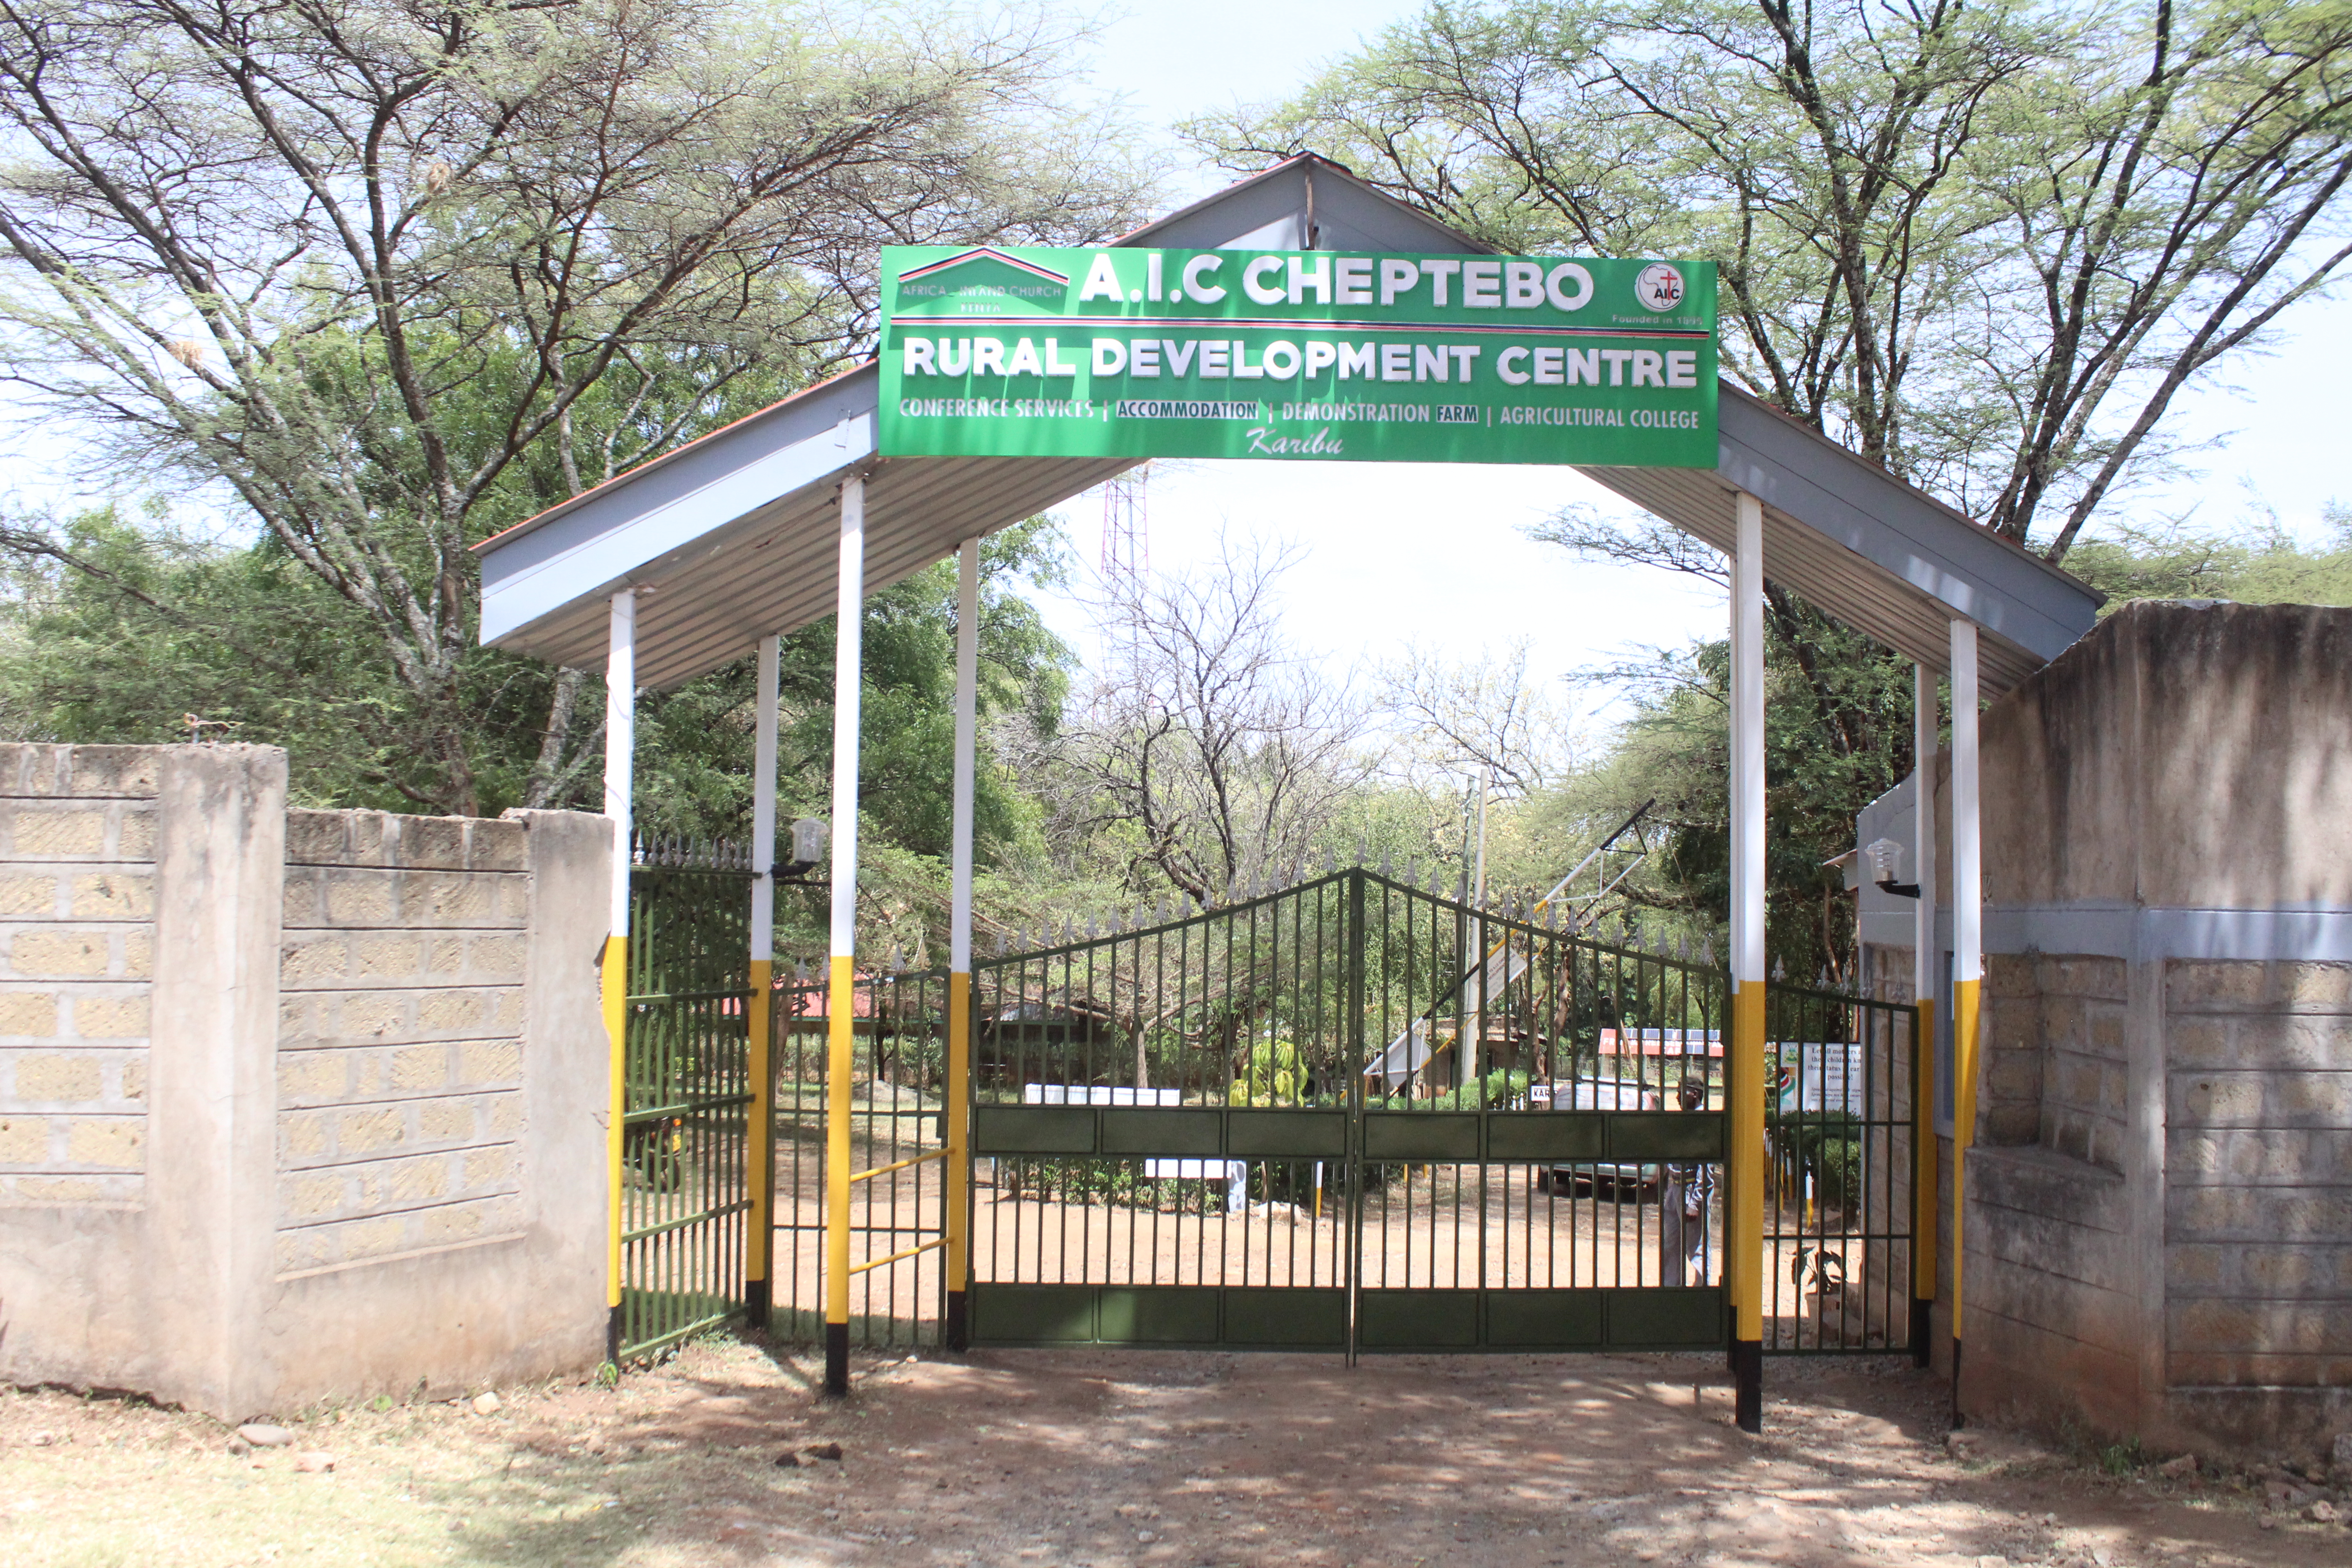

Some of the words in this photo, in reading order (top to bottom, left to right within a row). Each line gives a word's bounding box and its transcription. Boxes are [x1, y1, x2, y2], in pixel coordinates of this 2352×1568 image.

[902, 285, 946, 296] AFRICA
[960, 285, 1006, 296] INLAND
[1009, 285, 1061, 297] CHURCH
[1079, 253, 1227, 304] A.I.C
[1242, 255, 1594, 312] CHEPTEBO
[960, 302, 1001, 313] KENYA
[1612, 314, 1659, 323] Founded
[903, 337, 1076, 377] RURAL
[1091, 338, 1480, 382] DEVELOPMENT
[1496, 345, 1697, 388] CENTRE
[899, 398, 1009, 418] CONFERENCE
[1014, 399, 1094, 418] SERVICES
[1117, 400, 1257, 418] ACCOMMODATION
[1282, 402, 1430, 422] DEMONSTRATION
[1436, 406, 1478, 422] FARM
[1500, 406, 1625, 427] AGRICULTURAL
[1630, 409, 1699, 429] COLLEGE
[1246, 426, 1344, 455] Karibu
